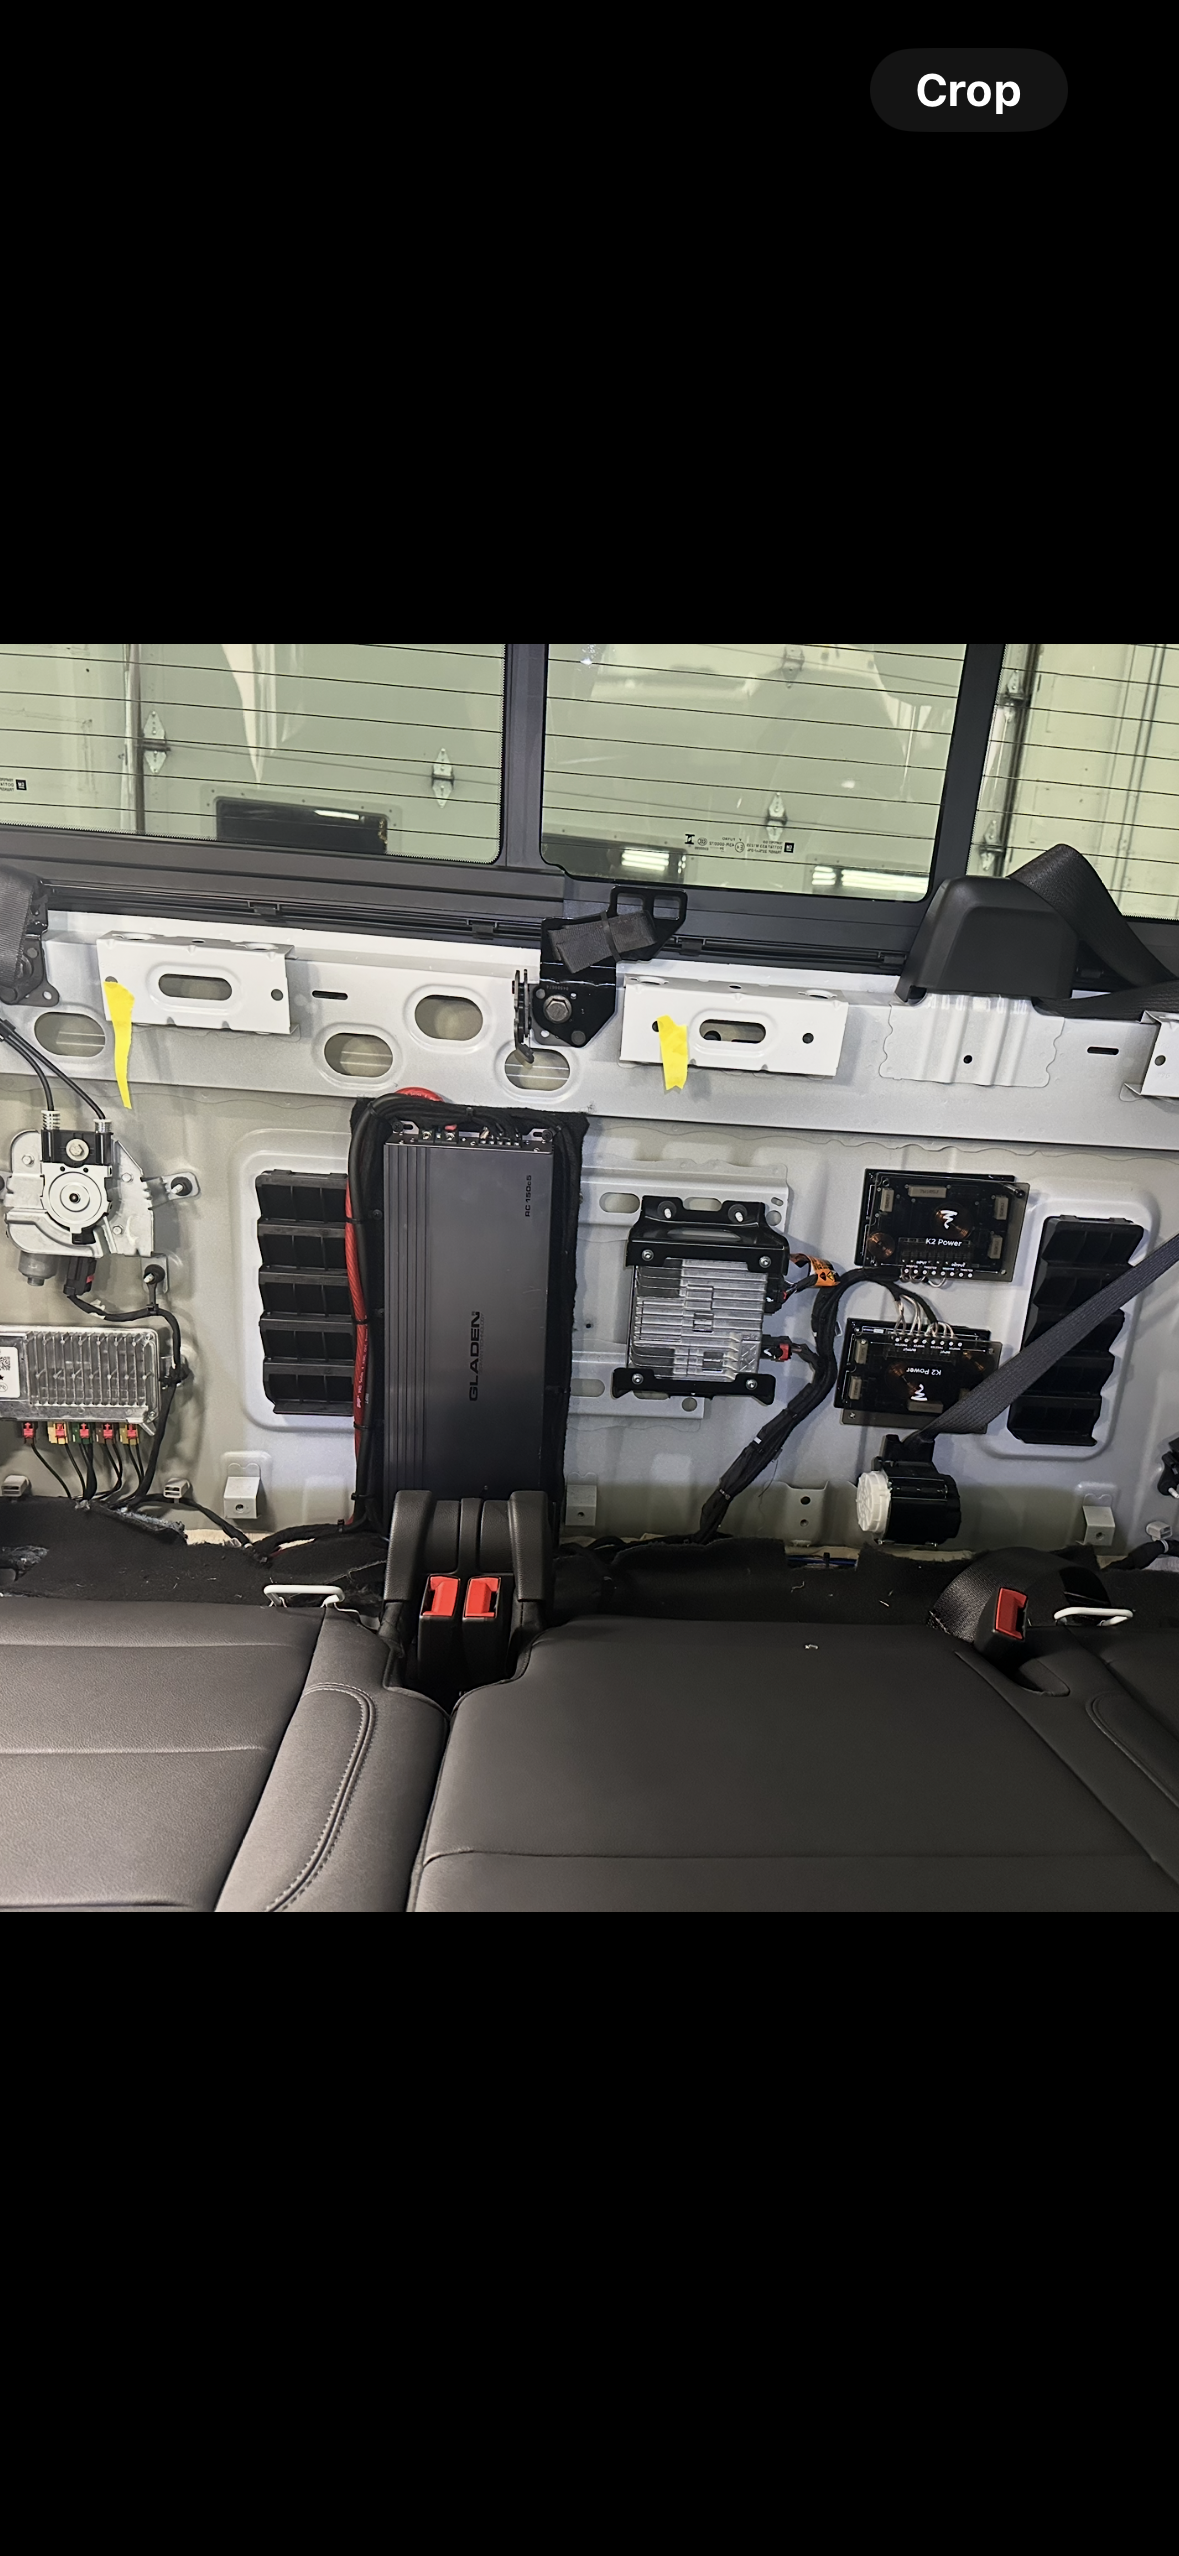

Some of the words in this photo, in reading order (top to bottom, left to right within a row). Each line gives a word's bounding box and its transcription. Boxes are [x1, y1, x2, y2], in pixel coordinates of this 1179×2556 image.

[525, 1205, 531, 1217] RC
[937, 1239, 962, 1247] Power
[469, 1312, 480, 1401] GLADEN
[906, 1367, 930, 1375] Power
